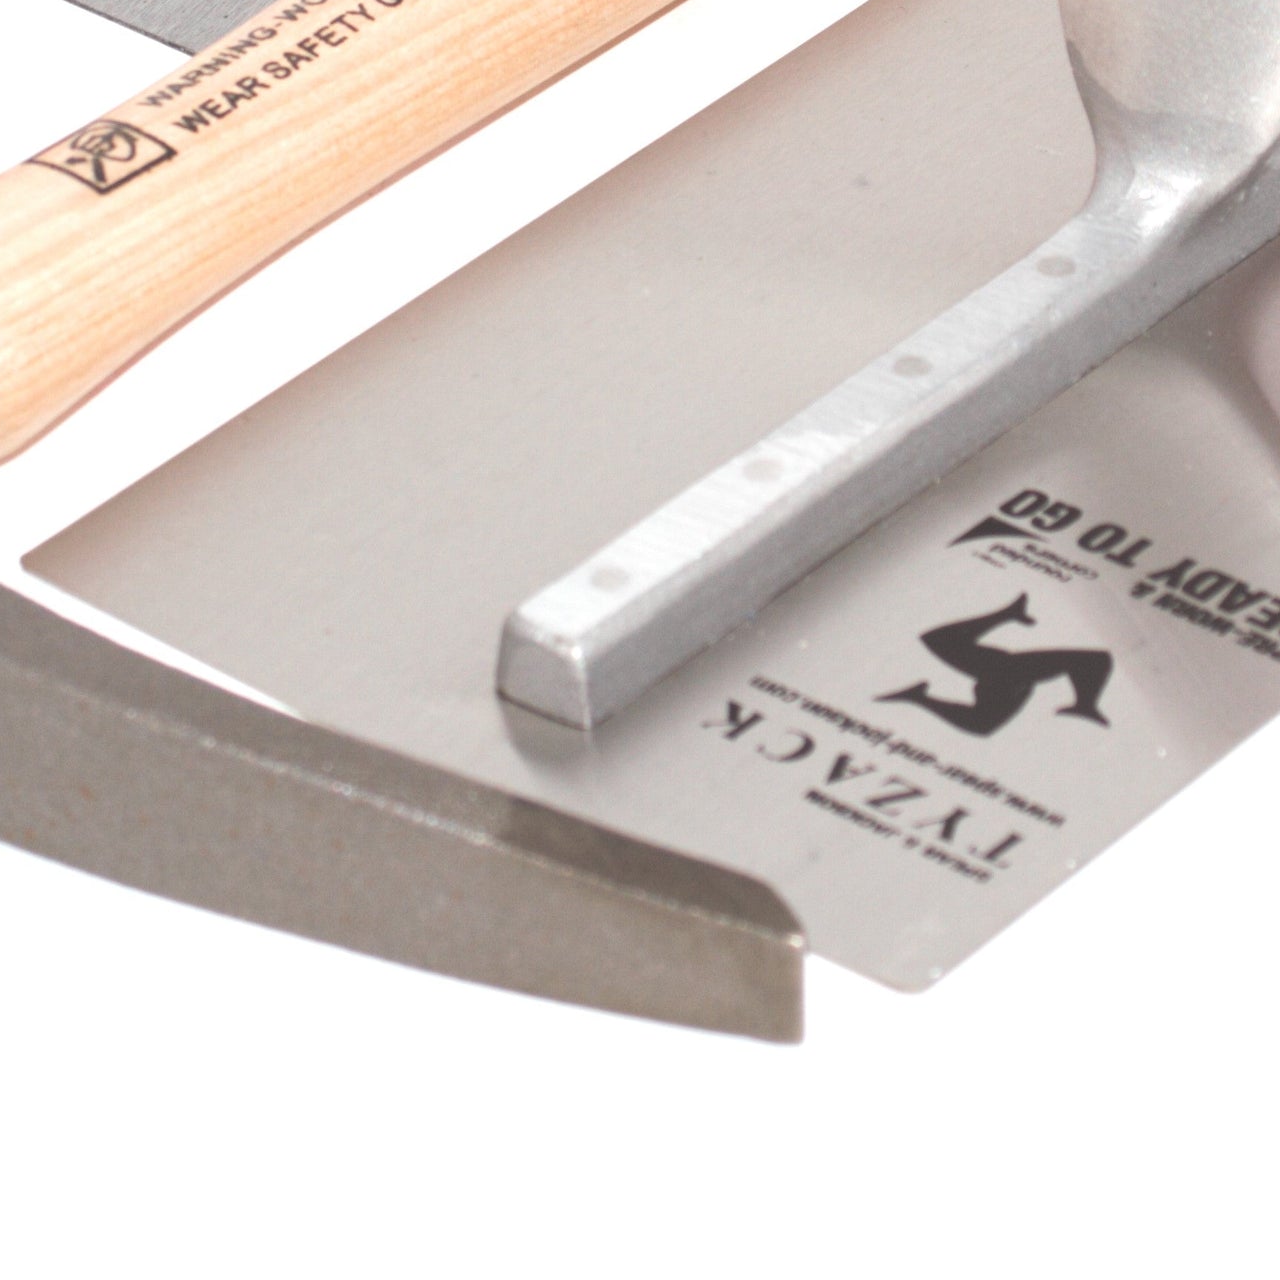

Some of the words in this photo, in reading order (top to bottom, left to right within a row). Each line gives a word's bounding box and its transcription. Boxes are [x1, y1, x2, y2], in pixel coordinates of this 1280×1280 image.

[171, 69, 272, 136] WEAR
[261, 1, 378, 82] SAFETY
[998, 488, 1084, 533] GO
[1076, 521, 1154, 568] TO
[700, 697, 1025, 871] TYZACK
[748, 673, 1068, 829] www.spear-and-jackson.com
